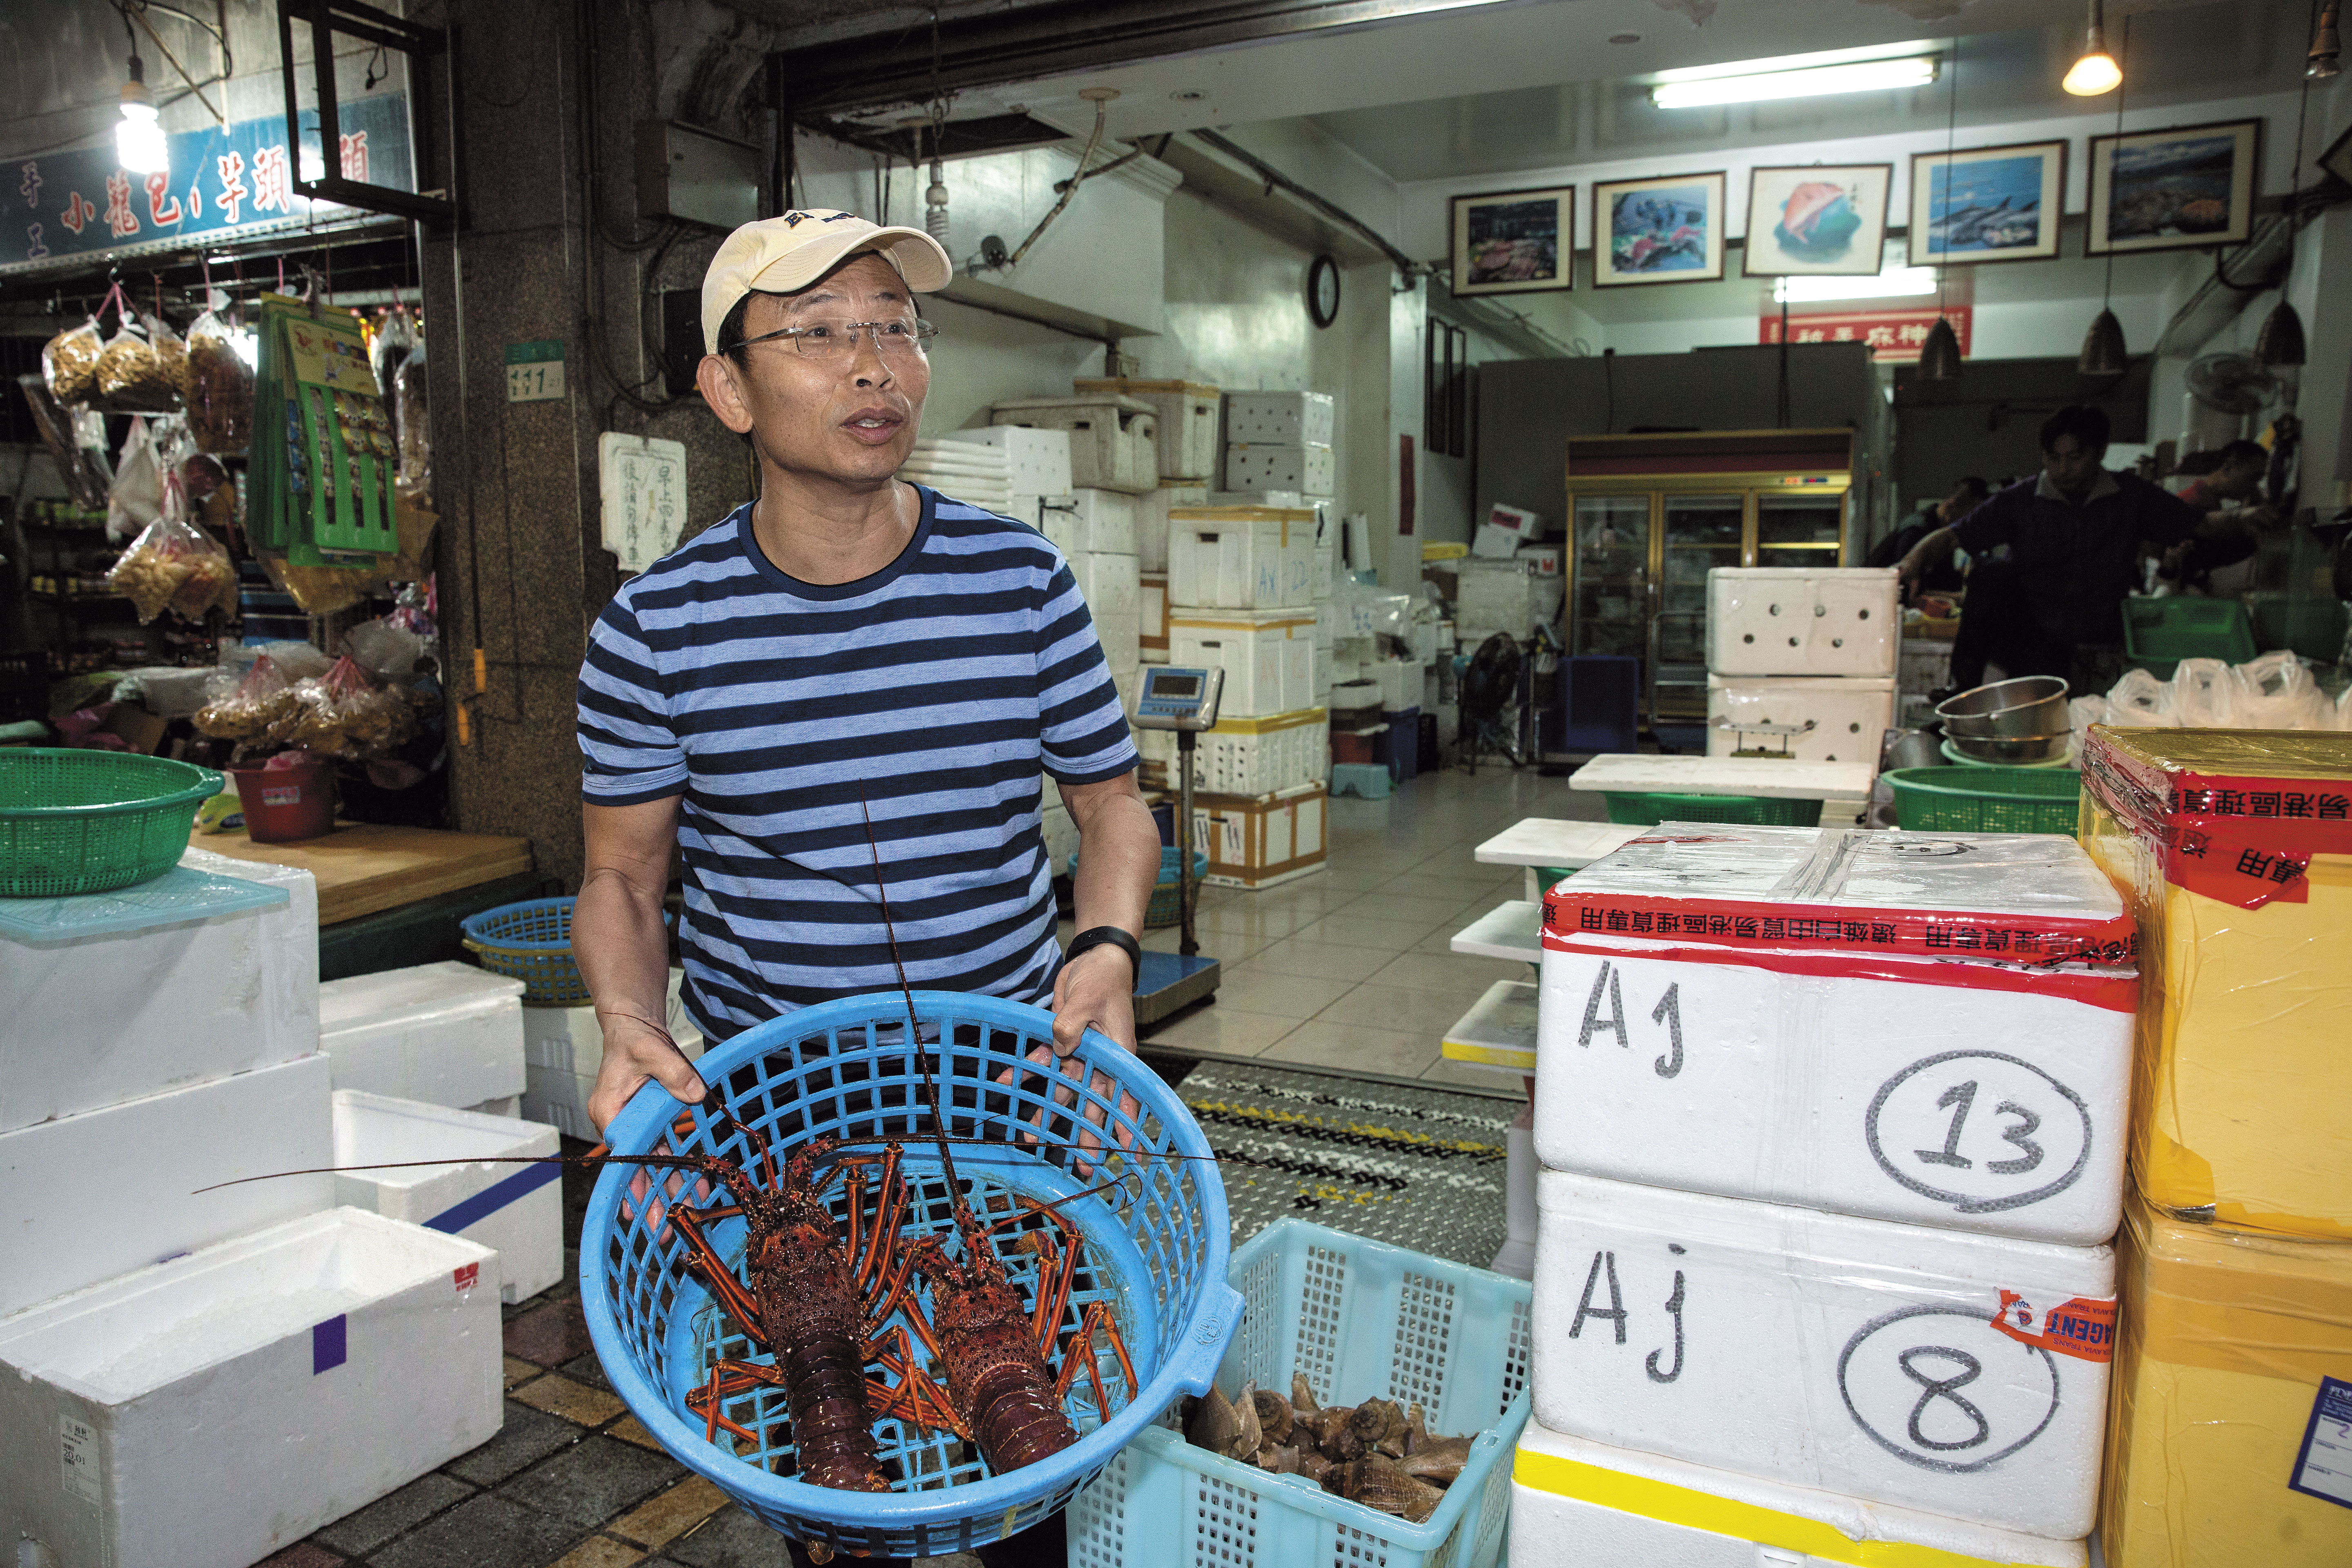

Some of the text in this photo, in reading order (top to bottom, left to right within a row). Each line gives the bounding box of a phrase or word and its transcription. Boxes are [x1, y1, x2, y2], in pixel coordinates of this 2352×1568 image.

[1914, 1080, 2045, 1174] 13
[2047, 1313, 2113, 1345] AGENT
[1898, 1346, 1989, 1450] 8
